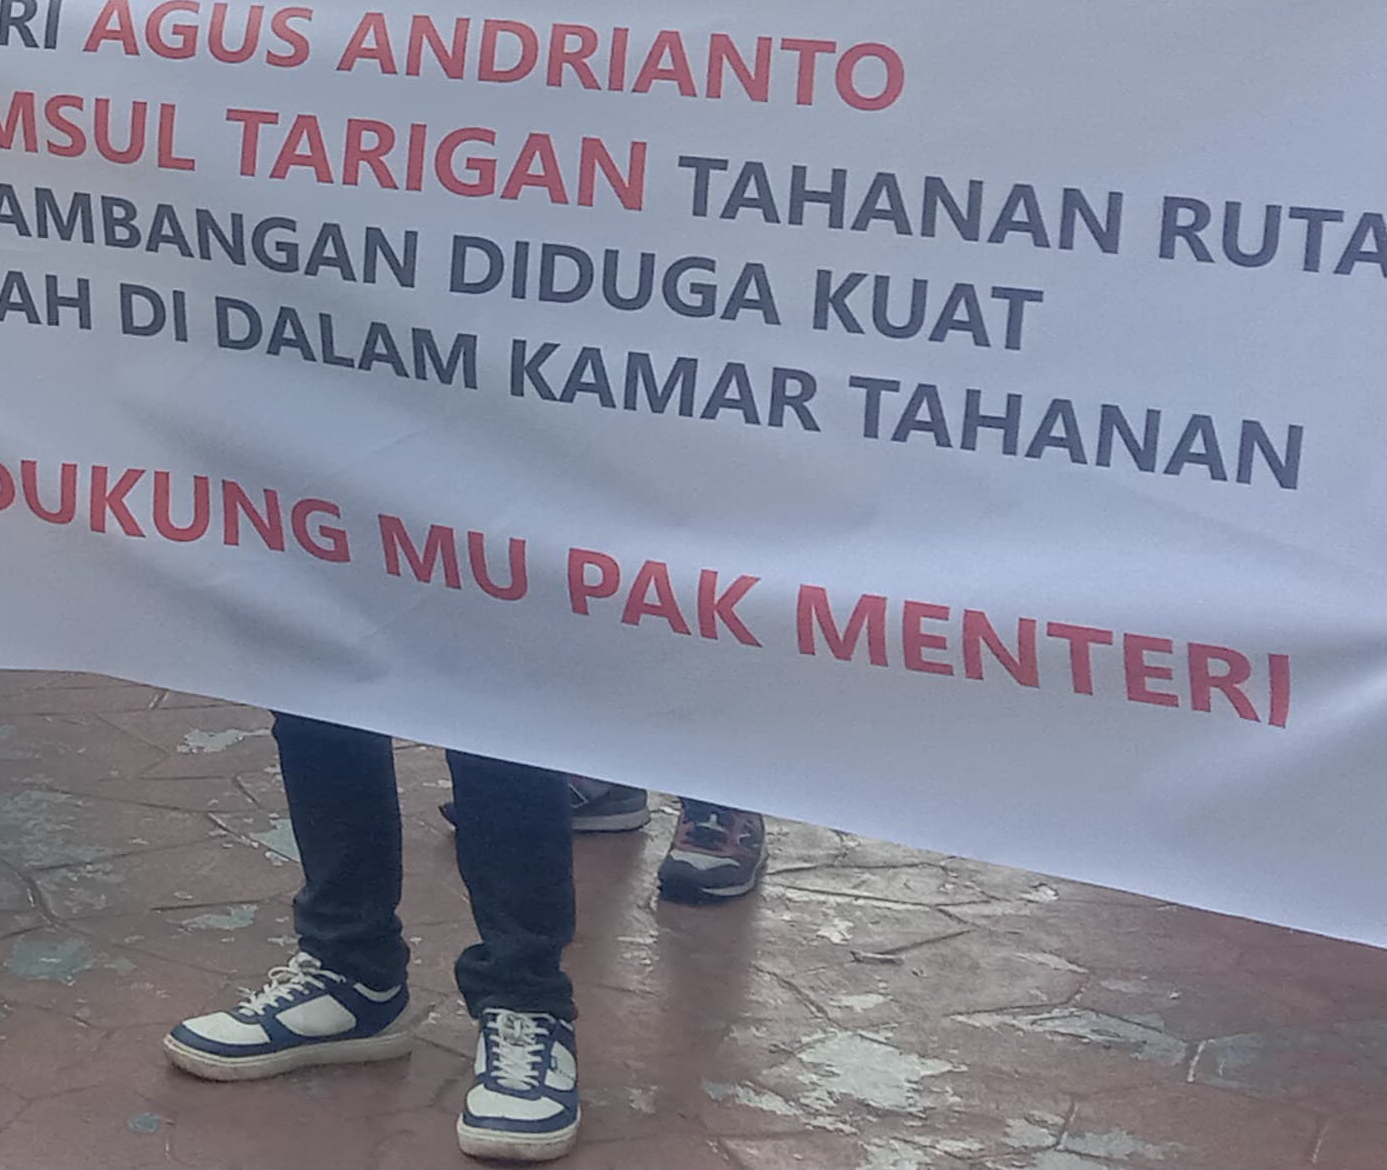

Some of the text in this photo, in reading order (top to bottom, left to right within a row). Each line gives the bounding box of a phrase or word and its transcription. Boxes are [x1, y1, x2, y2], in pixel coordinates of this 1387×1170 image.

[336, 10, 905, 112] ANDRIANTO
[226, 107, 648, 212] TARIGAN
[678, 155, 1124, 255] TAHANAN
[449, 233, 781, 326] DIDUGA
[812, 269, 1044, 351] KUAT
[120, 283, 188, 344] DI
[215, 296, 478, 391] DALAM
[510, 338, 821, 433] KAMAR
[849, 375, 1304, 490] TAHANAN
[378, 513, 528, 601] MU
[567, 547, 763, 648] PAK
[796, 584, 1292, 729] MENTERI
